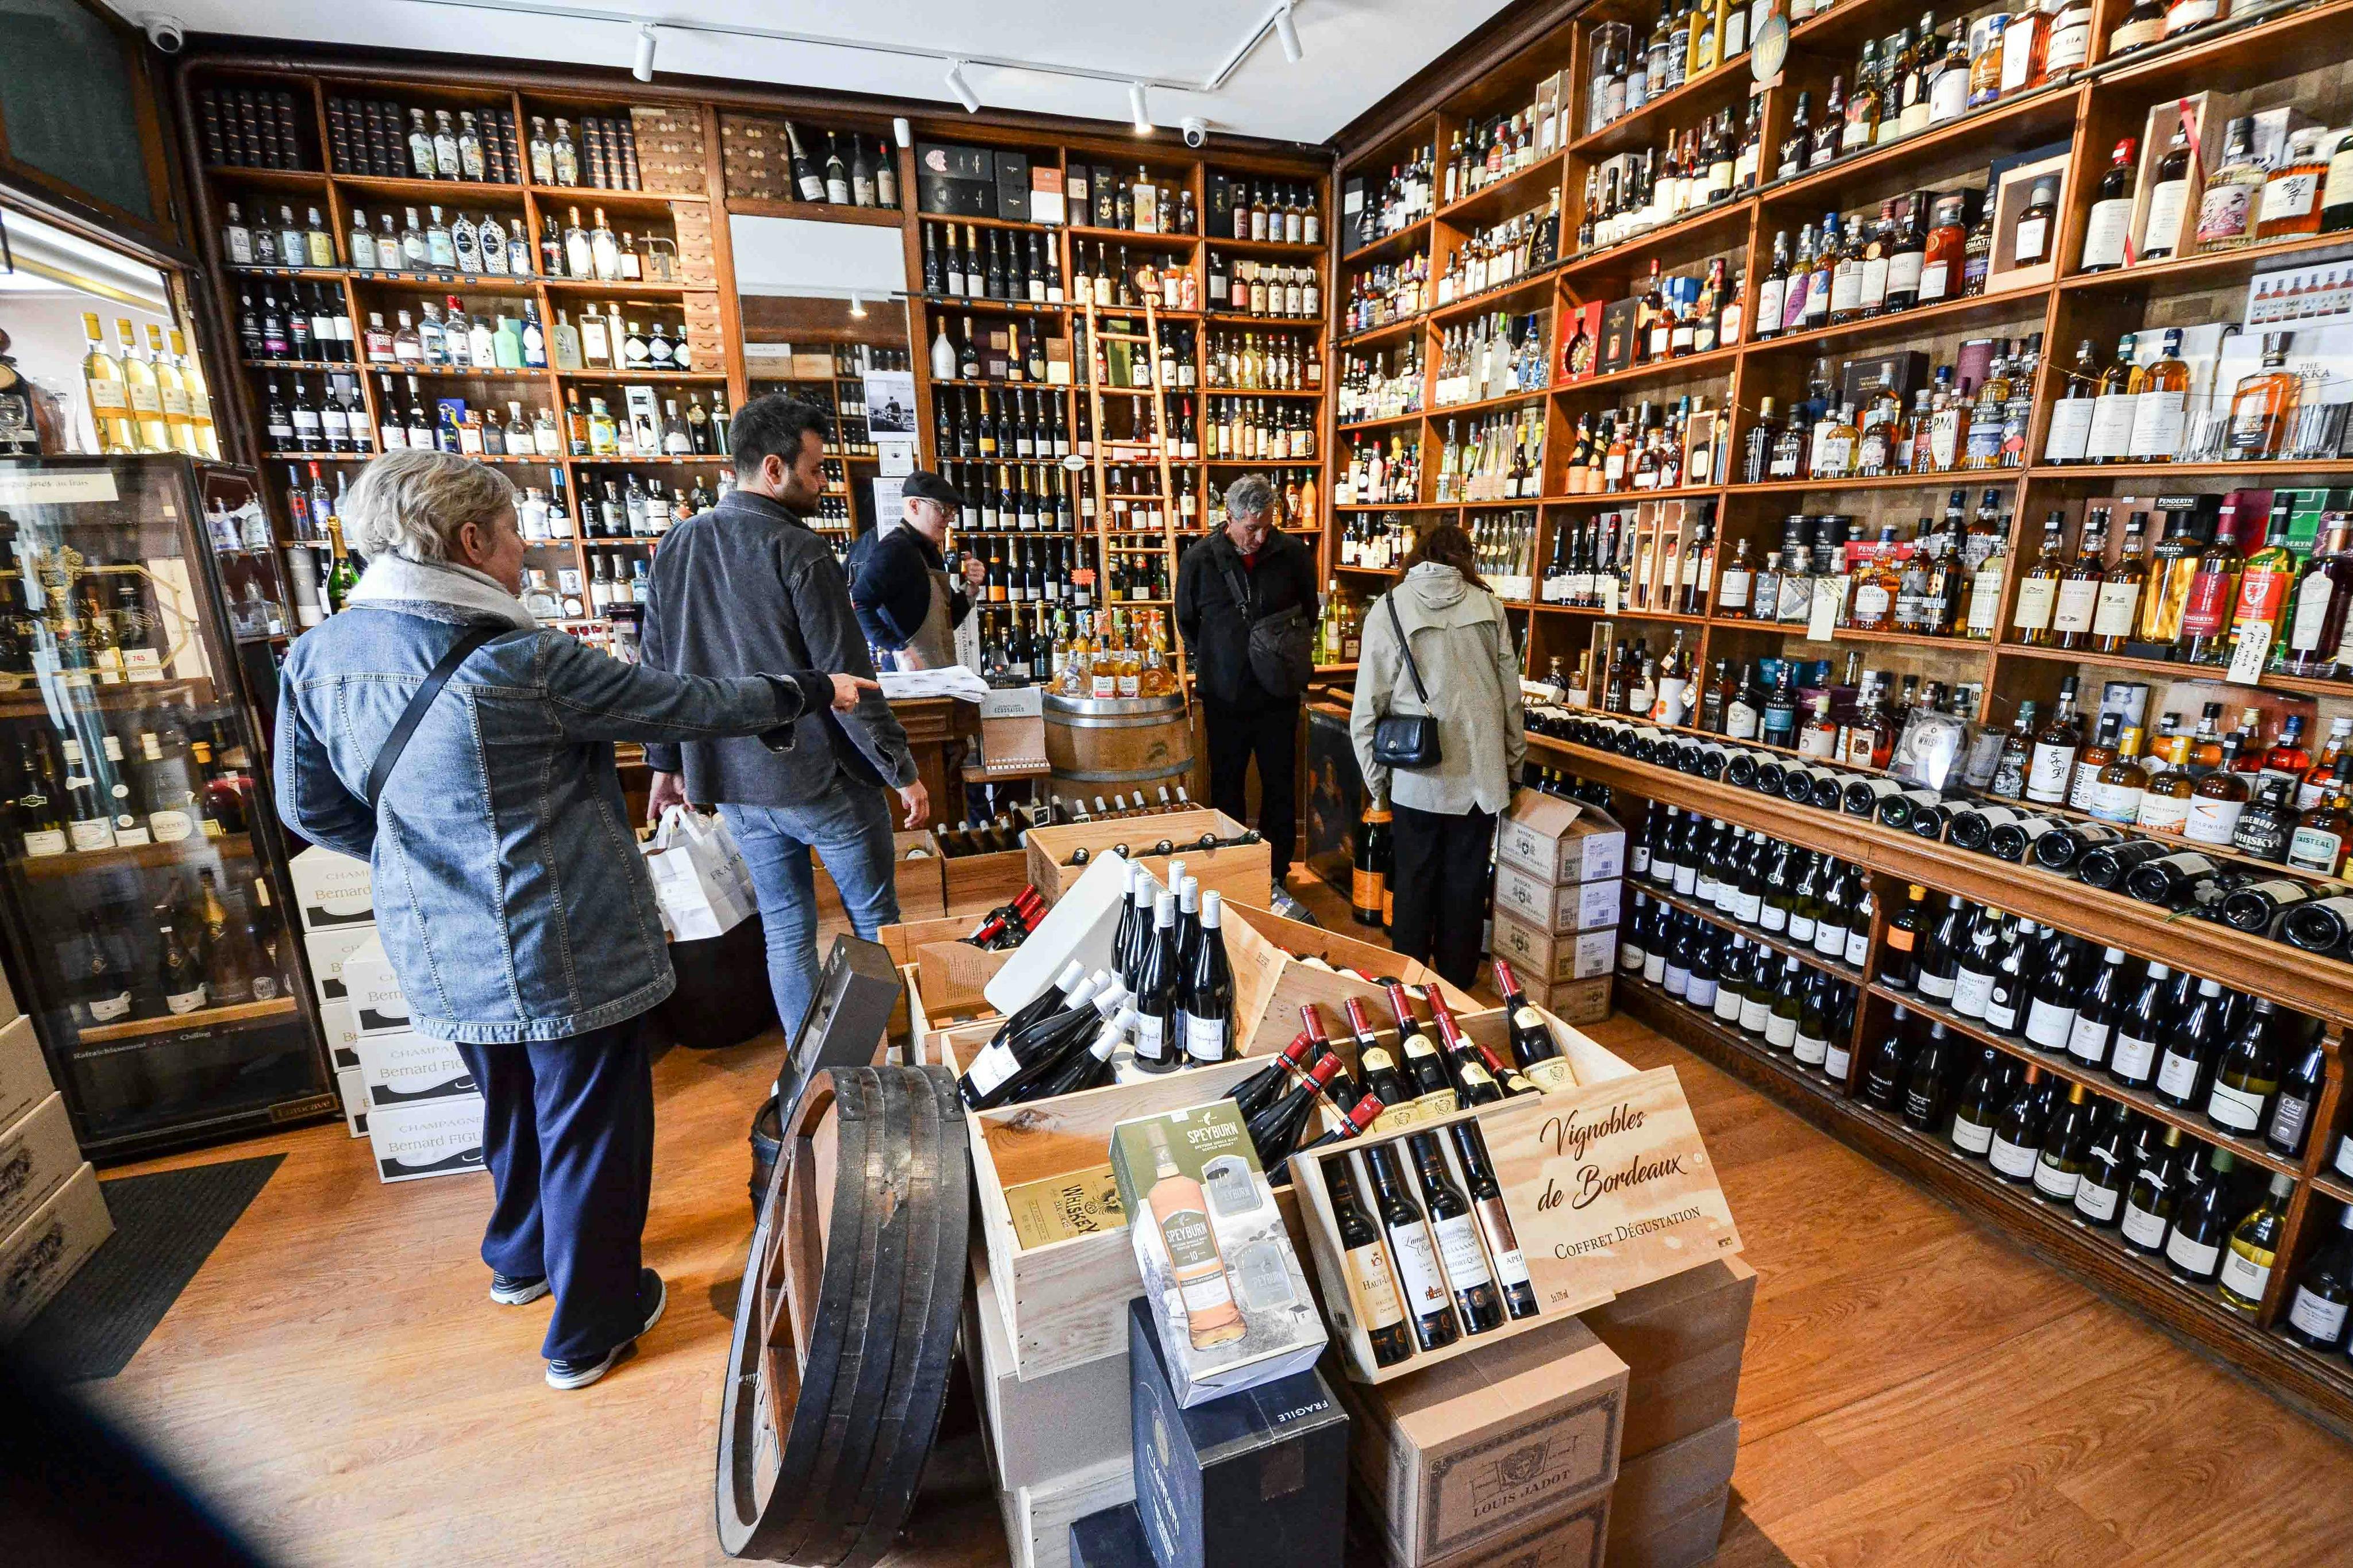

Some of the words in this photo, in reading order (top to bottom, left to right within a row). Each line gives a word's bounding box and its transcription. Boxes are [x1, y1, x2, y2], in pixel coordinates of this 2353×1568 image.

[1965, 237, 1991, 249] OMATI
[2298, 369, 2331, 380] KKA
[2299, 361, 2321, 370] THE
[1918, 736, 1938, 747] WHIS
[2070, 765, 2086, 805] FLATNOSE
[315, 884, 371, 900] Bernard
[380, 1053, 437, 1073] Bernard
[2282, 1098, 2303, 1112] Clos
[1187, 1122, 1239, 1144] SPEYBURN
[1540, 1103, 1648, 1161] Vignobles
[388, 1135, 445, 1152] Bernard
[1537, 1179, 1564, 1212] de
[1572, 1154, 1688, 1210] Bordeaux
[1061, 1184, 1101, 1235] WHISKEY
[1166, 1222, 1208, 1242] SPEYBURN
[1189, 1250, 1198, 1262] 10
[1278, 1399, 1329, 1422] FRAGILE
[1473, 1495, 1515, 1517] LOUIS
[1521, 1469, 1571, 1494] JADOT
